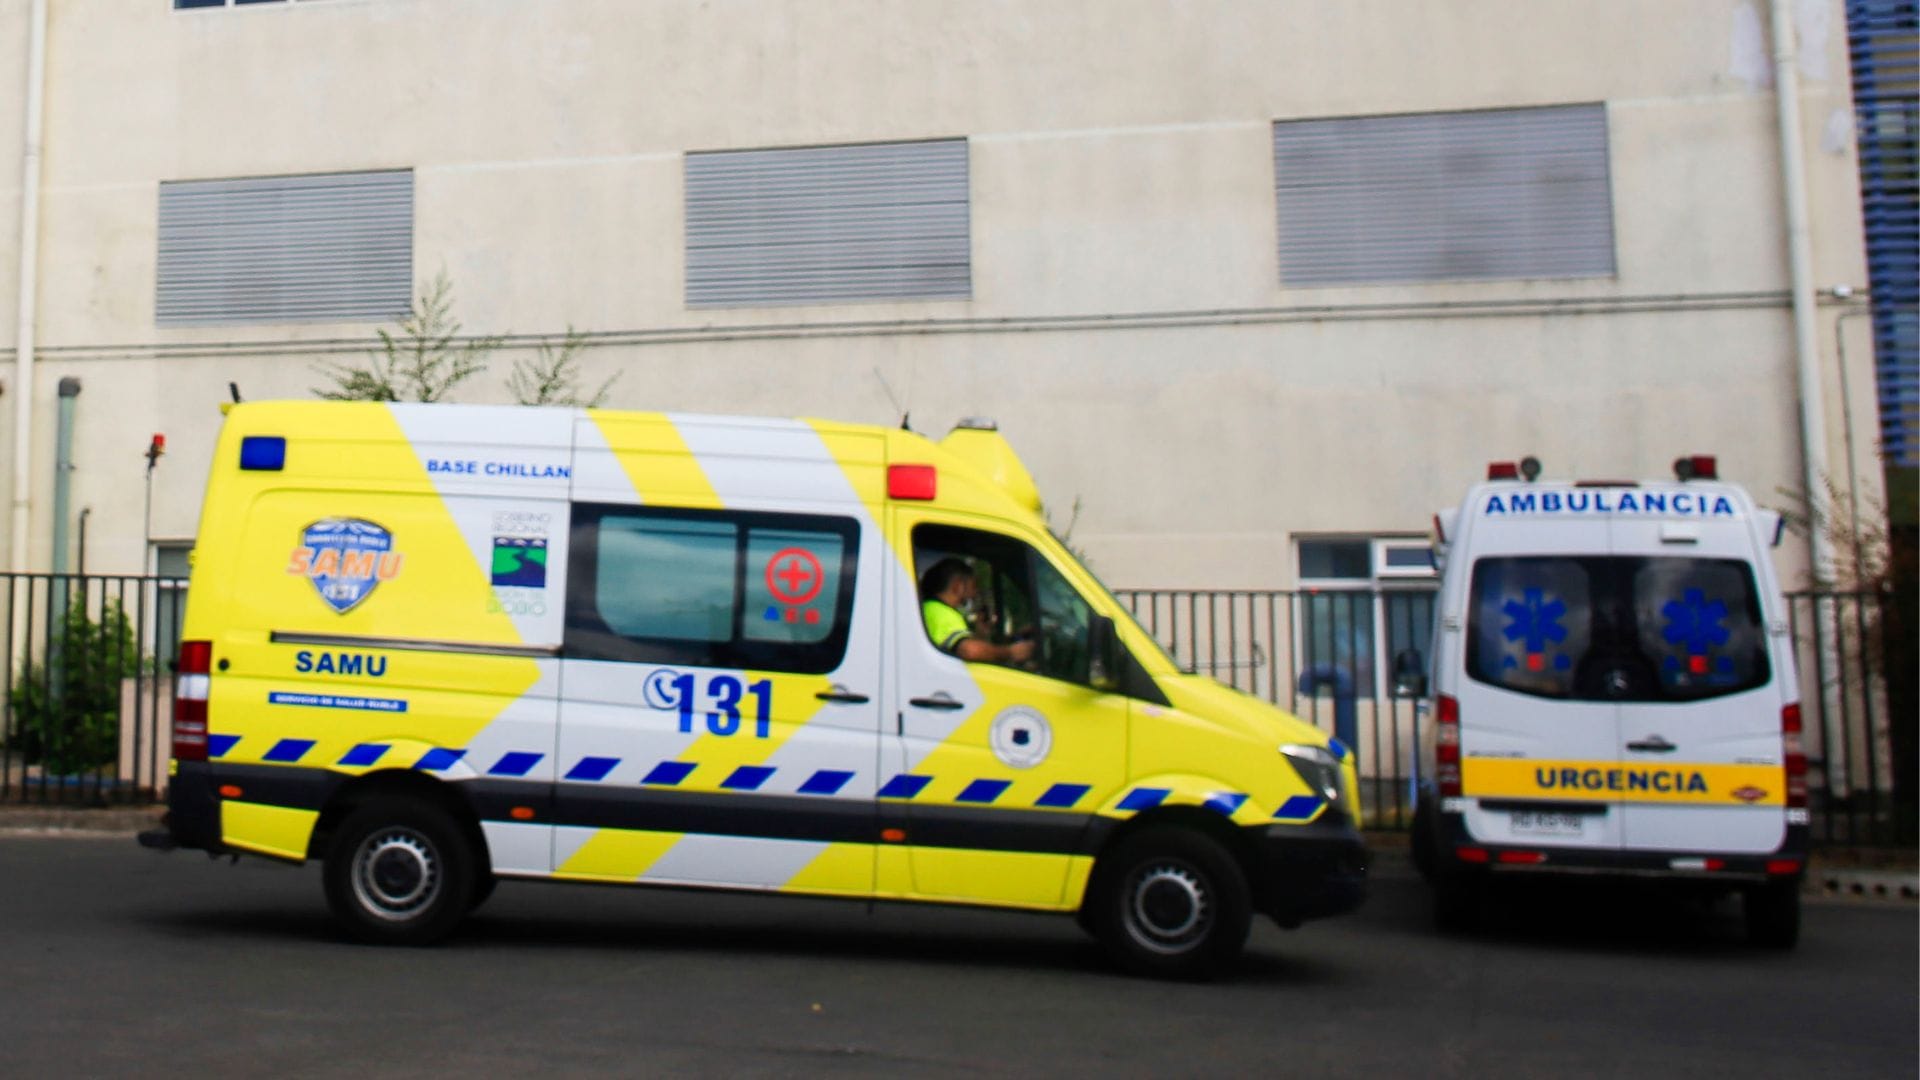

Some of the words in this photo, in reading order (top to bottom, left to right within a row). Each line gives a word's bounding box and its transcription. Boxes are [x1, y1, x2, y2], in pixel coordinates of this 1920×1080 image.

[426, 459, 477, 474] BASE
[484, 462, 570, 478] CHILLAN
[1485, 491, 1733, 515] AMBULANCIA
[286, 546, 404, 581] SAMU
[295, 650, 387, 677] SAMU
[670, 673, 772, 739] 131
[1535, 767, 1709, 794] URGENCIA
